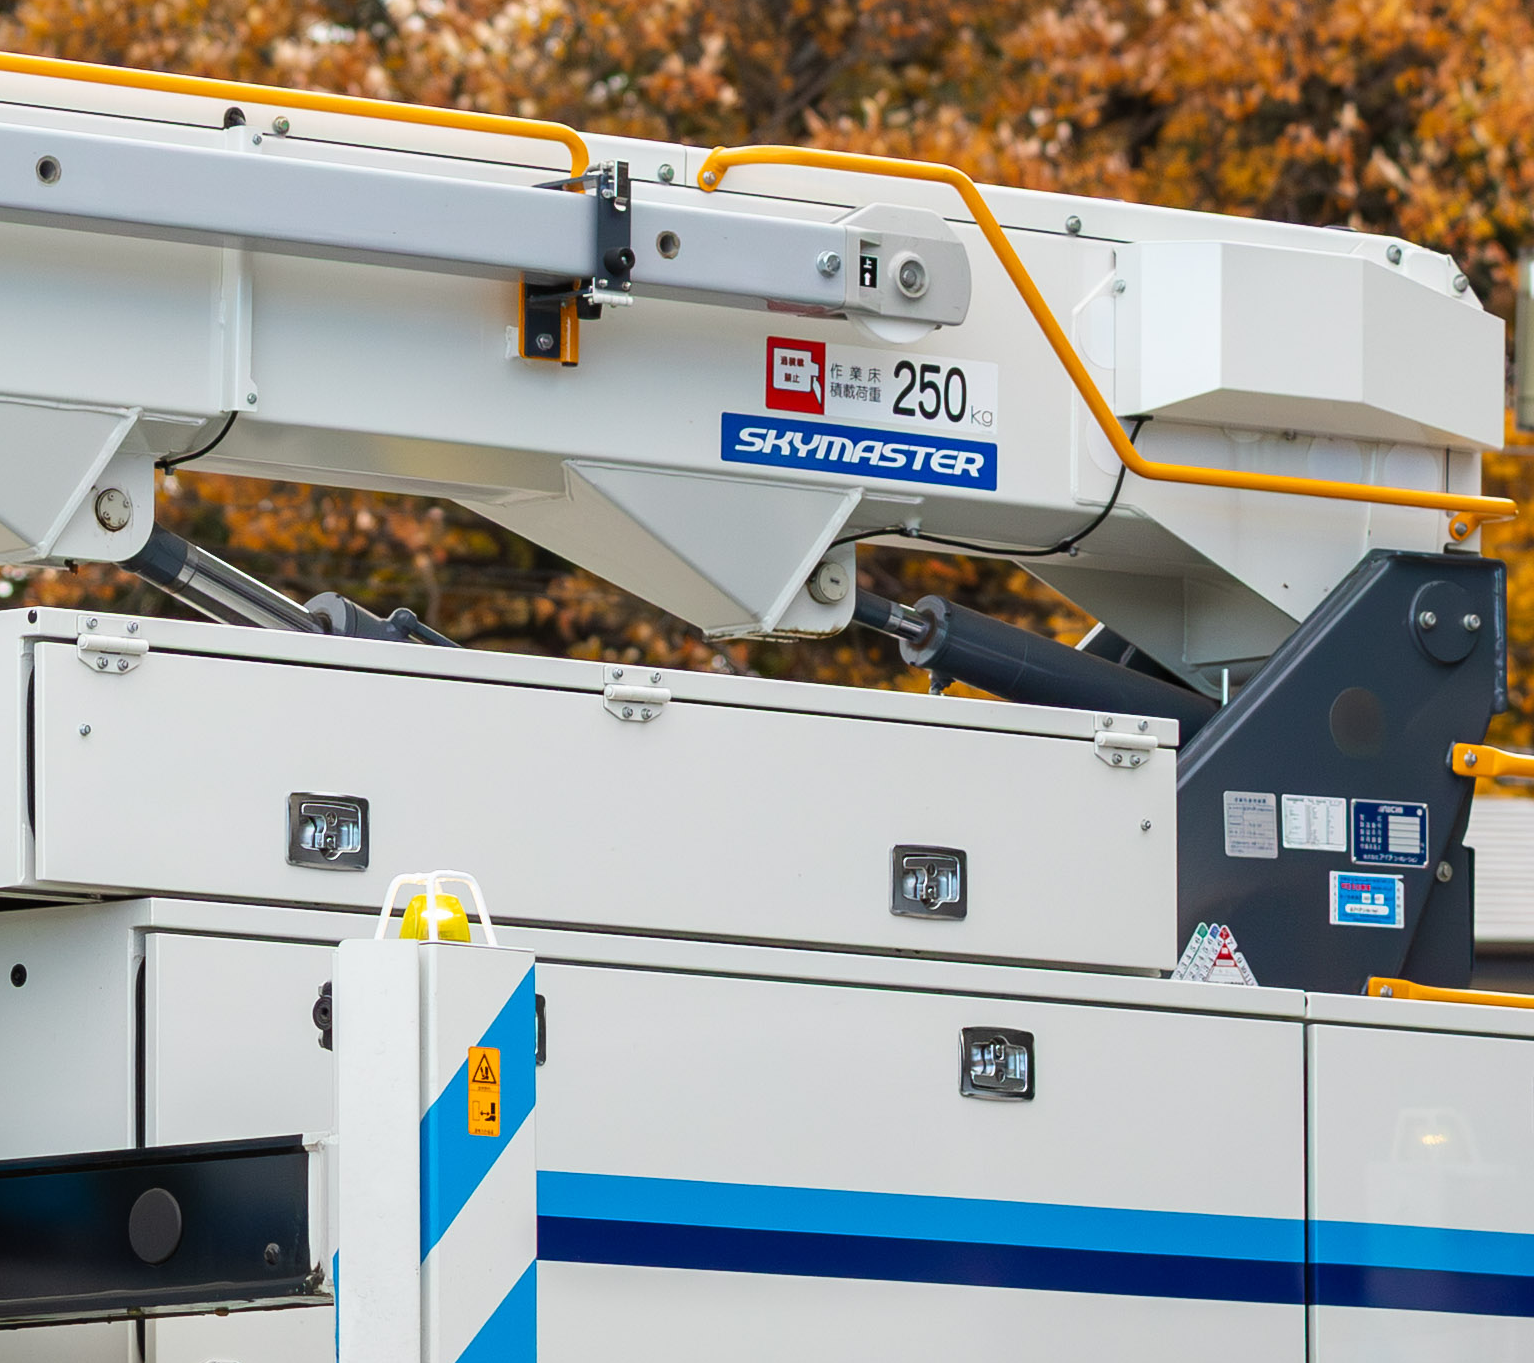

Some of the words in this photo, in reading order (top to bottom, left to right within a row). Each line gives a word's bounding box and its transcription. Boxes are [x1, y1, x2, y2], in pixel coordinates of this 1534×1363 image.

[830, 362, 882, 383] 作業床
[830, 381, 882, 403] 積載荷重
[734, 427, 985, 478] SKYMASTER
